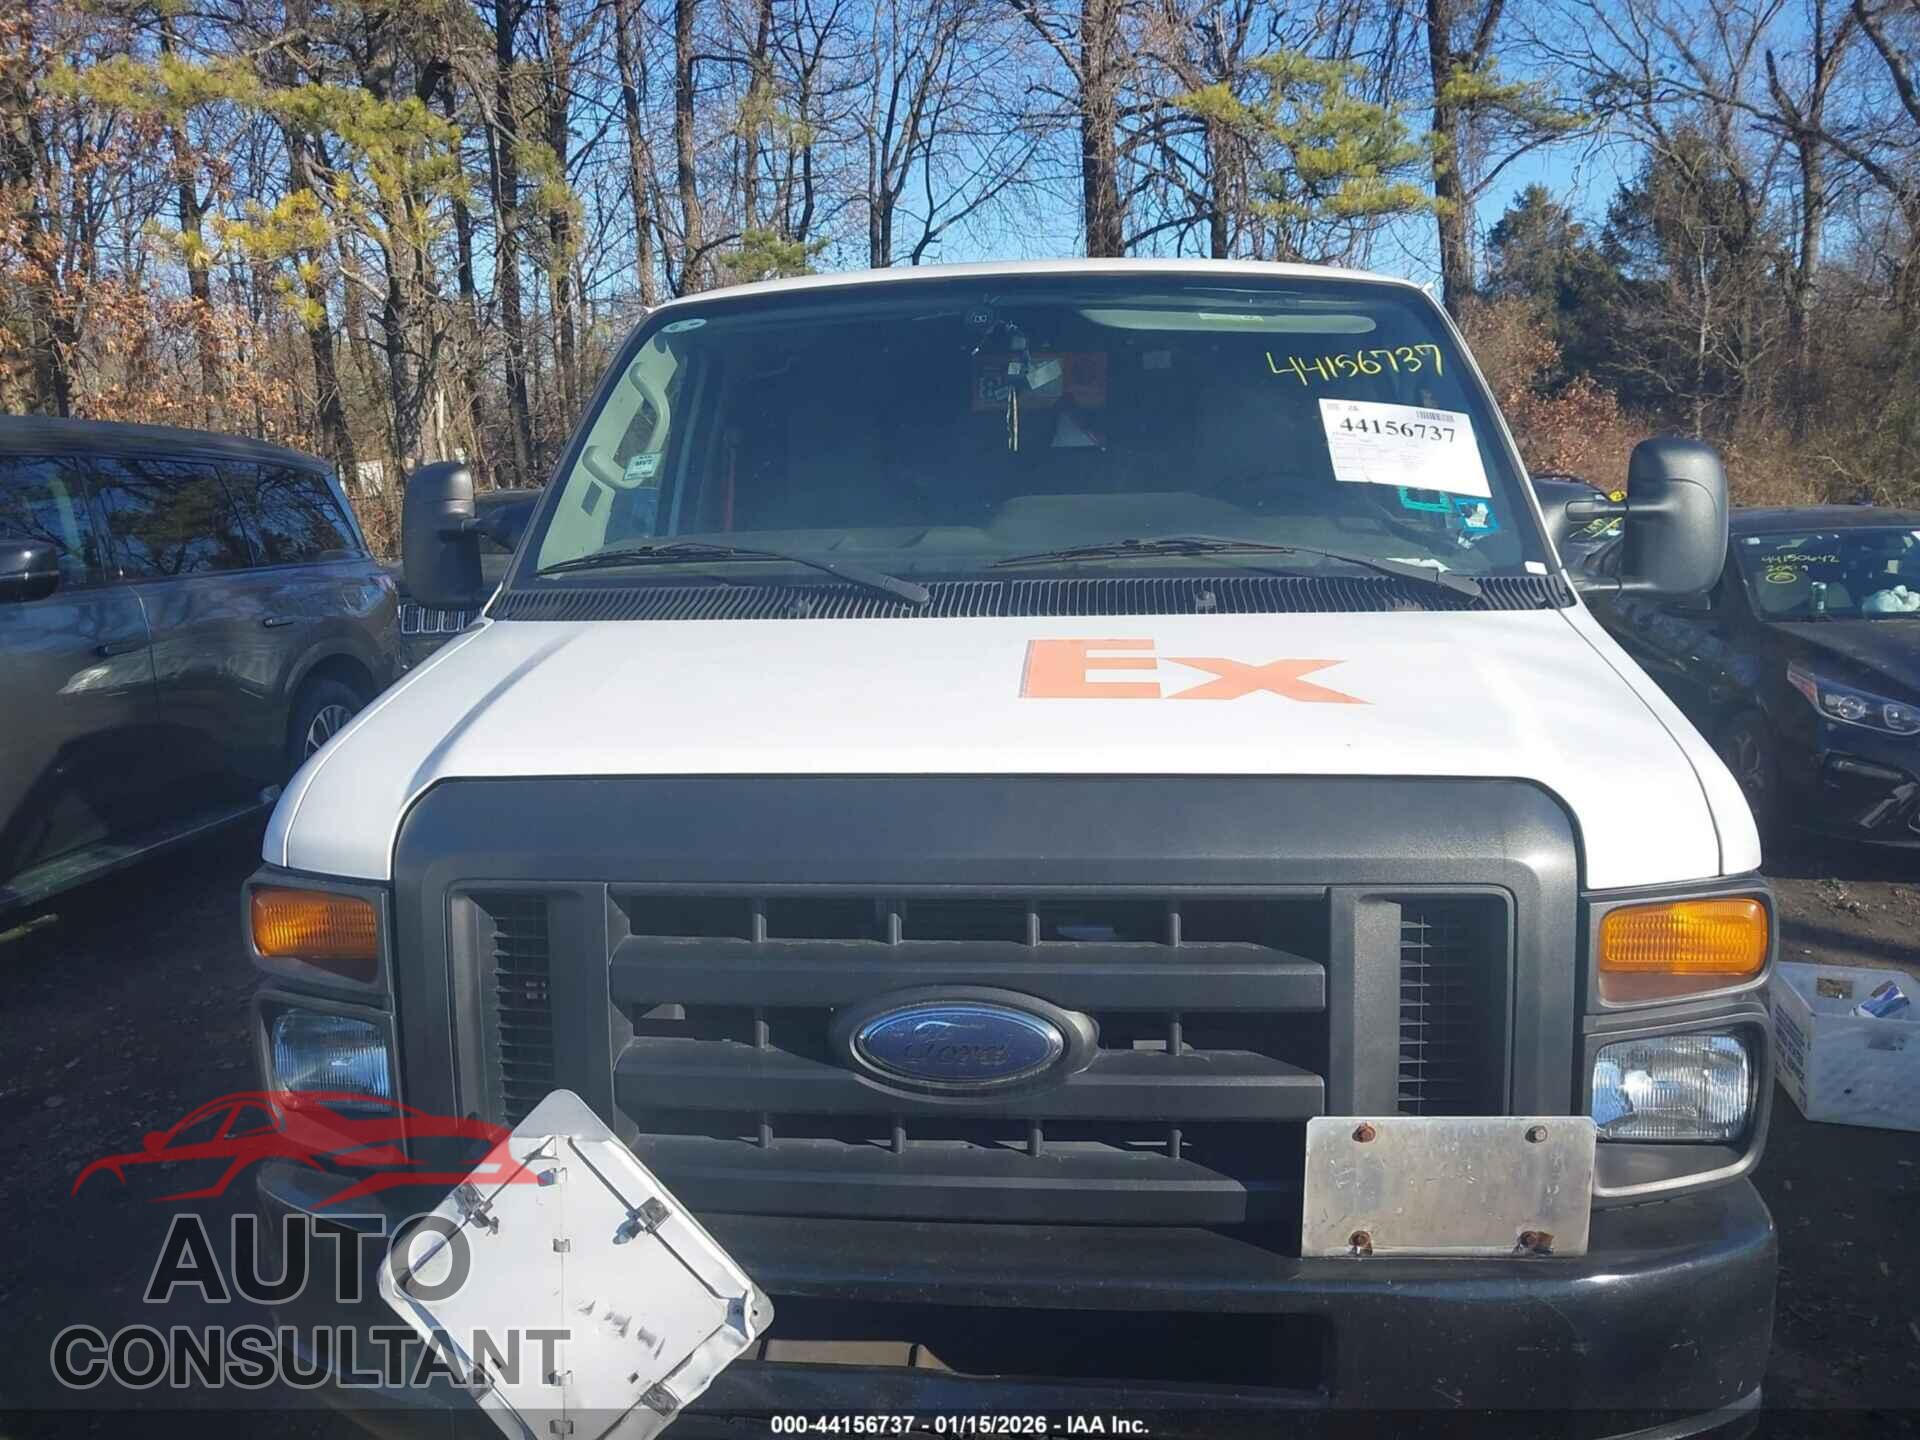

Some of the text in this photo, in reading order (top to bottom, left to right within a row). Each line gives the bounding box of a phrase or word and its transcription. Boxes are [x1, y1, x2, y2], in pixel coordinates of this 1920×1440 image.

[1266, 344, 1443, 386] 44156737
[1339, 417, 1456, 443] 44156737
[1018, 639, 1376, 705] Ex
